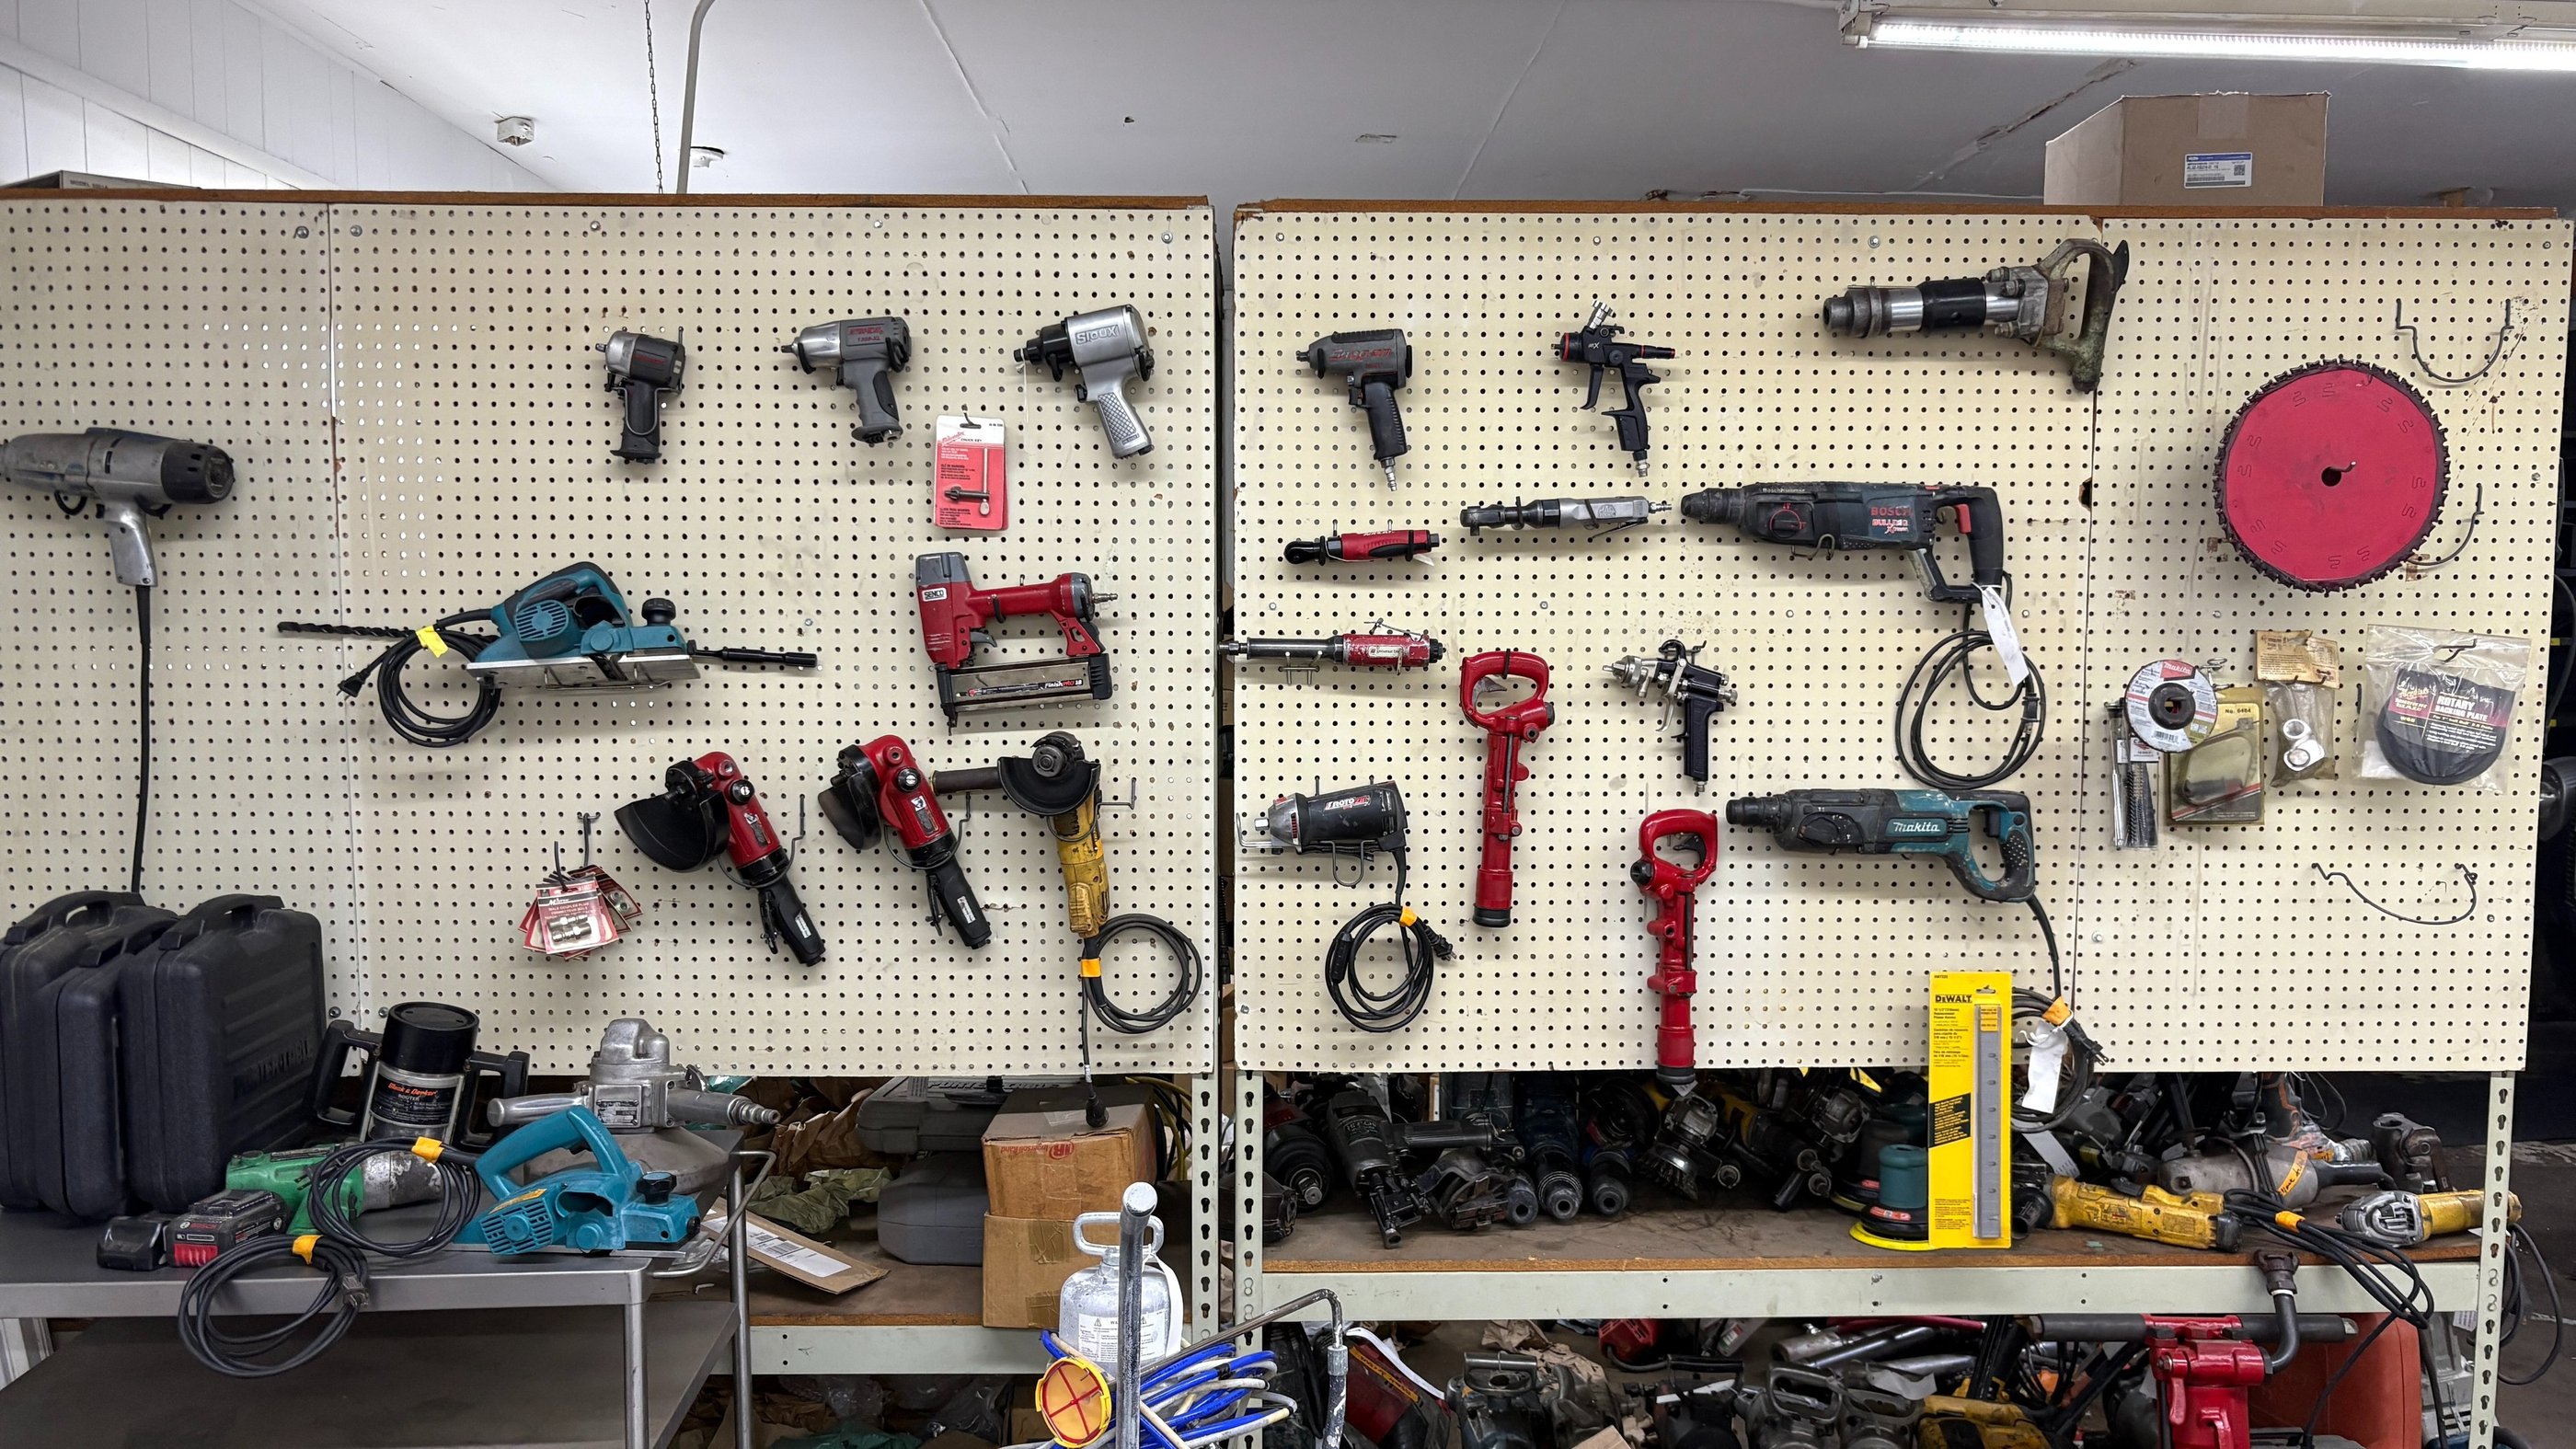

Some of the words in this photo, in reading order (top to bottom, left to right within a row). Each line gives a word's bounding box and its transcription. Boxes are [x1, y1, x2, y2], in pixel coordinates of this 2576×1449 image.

[1075, 324, 1120, 345] SIOUX
[924, 590, 945, 600] SENCO
[2436, 695, 2476, 711] ROTARY
[2434, 704, 2467, 719] BACKING
[2466, 710, 2489, 722] PLATE
[1893, 822, 1941, 832] Makita
[387, 1082, 406, 1093] Black
[410, 1088, 439, 1097] Decker
